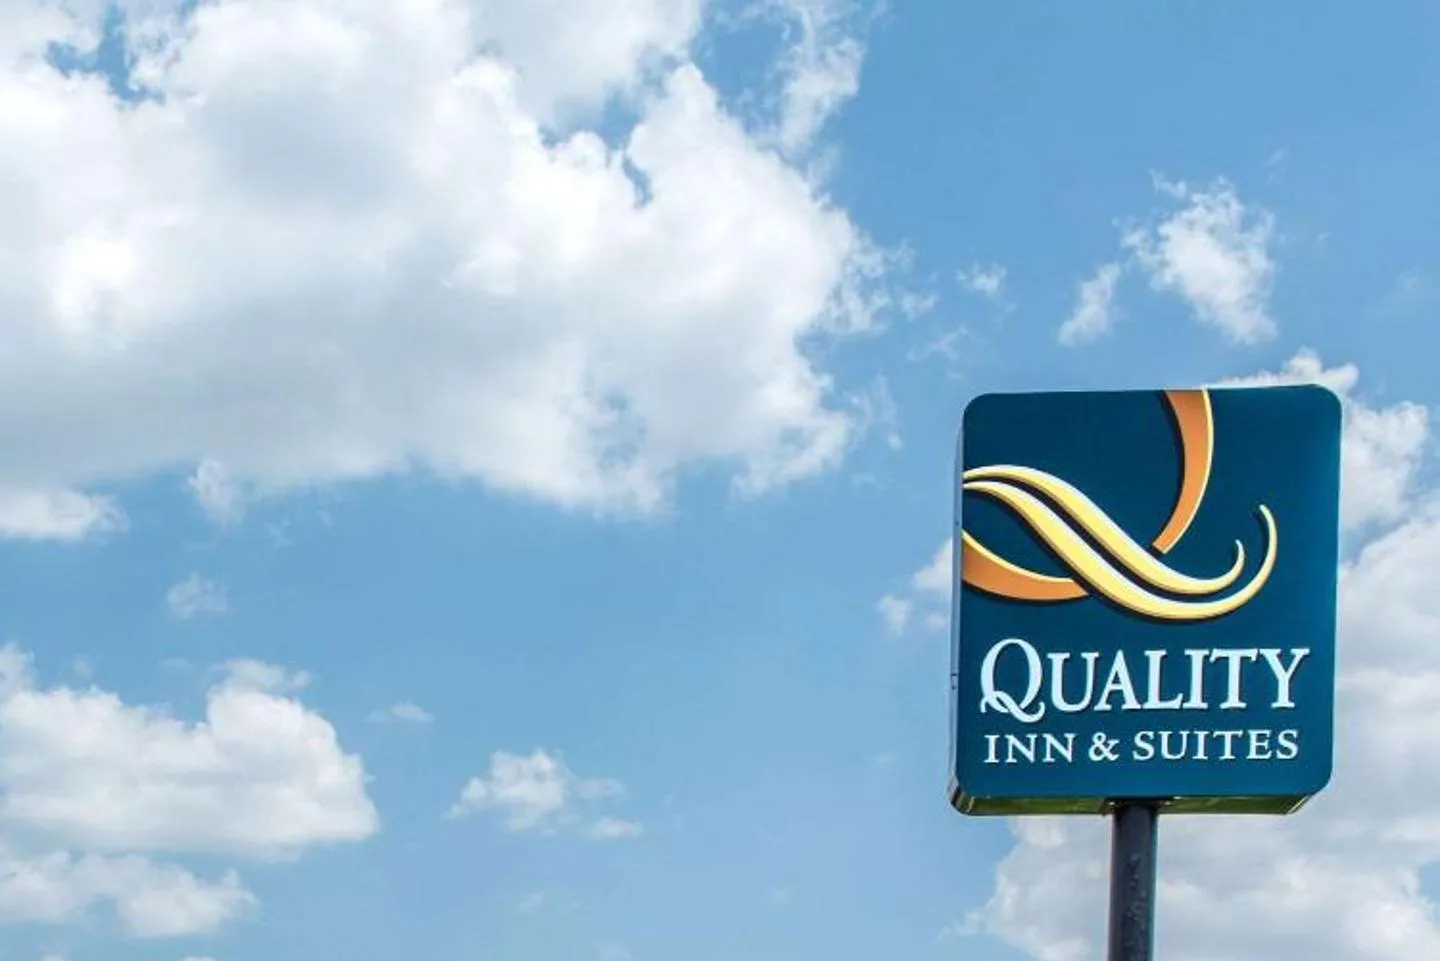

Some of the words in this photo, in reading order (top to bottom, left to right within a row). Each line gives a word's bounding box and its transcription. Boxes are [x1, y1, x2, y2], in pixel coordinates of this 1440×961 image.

[980, 638, 1309, 723] QUALITY
[984, 733, 1075, 763] INN
[1088, 732, 1119, 760] &
[1132, 730, 1299, 760] SUITES
